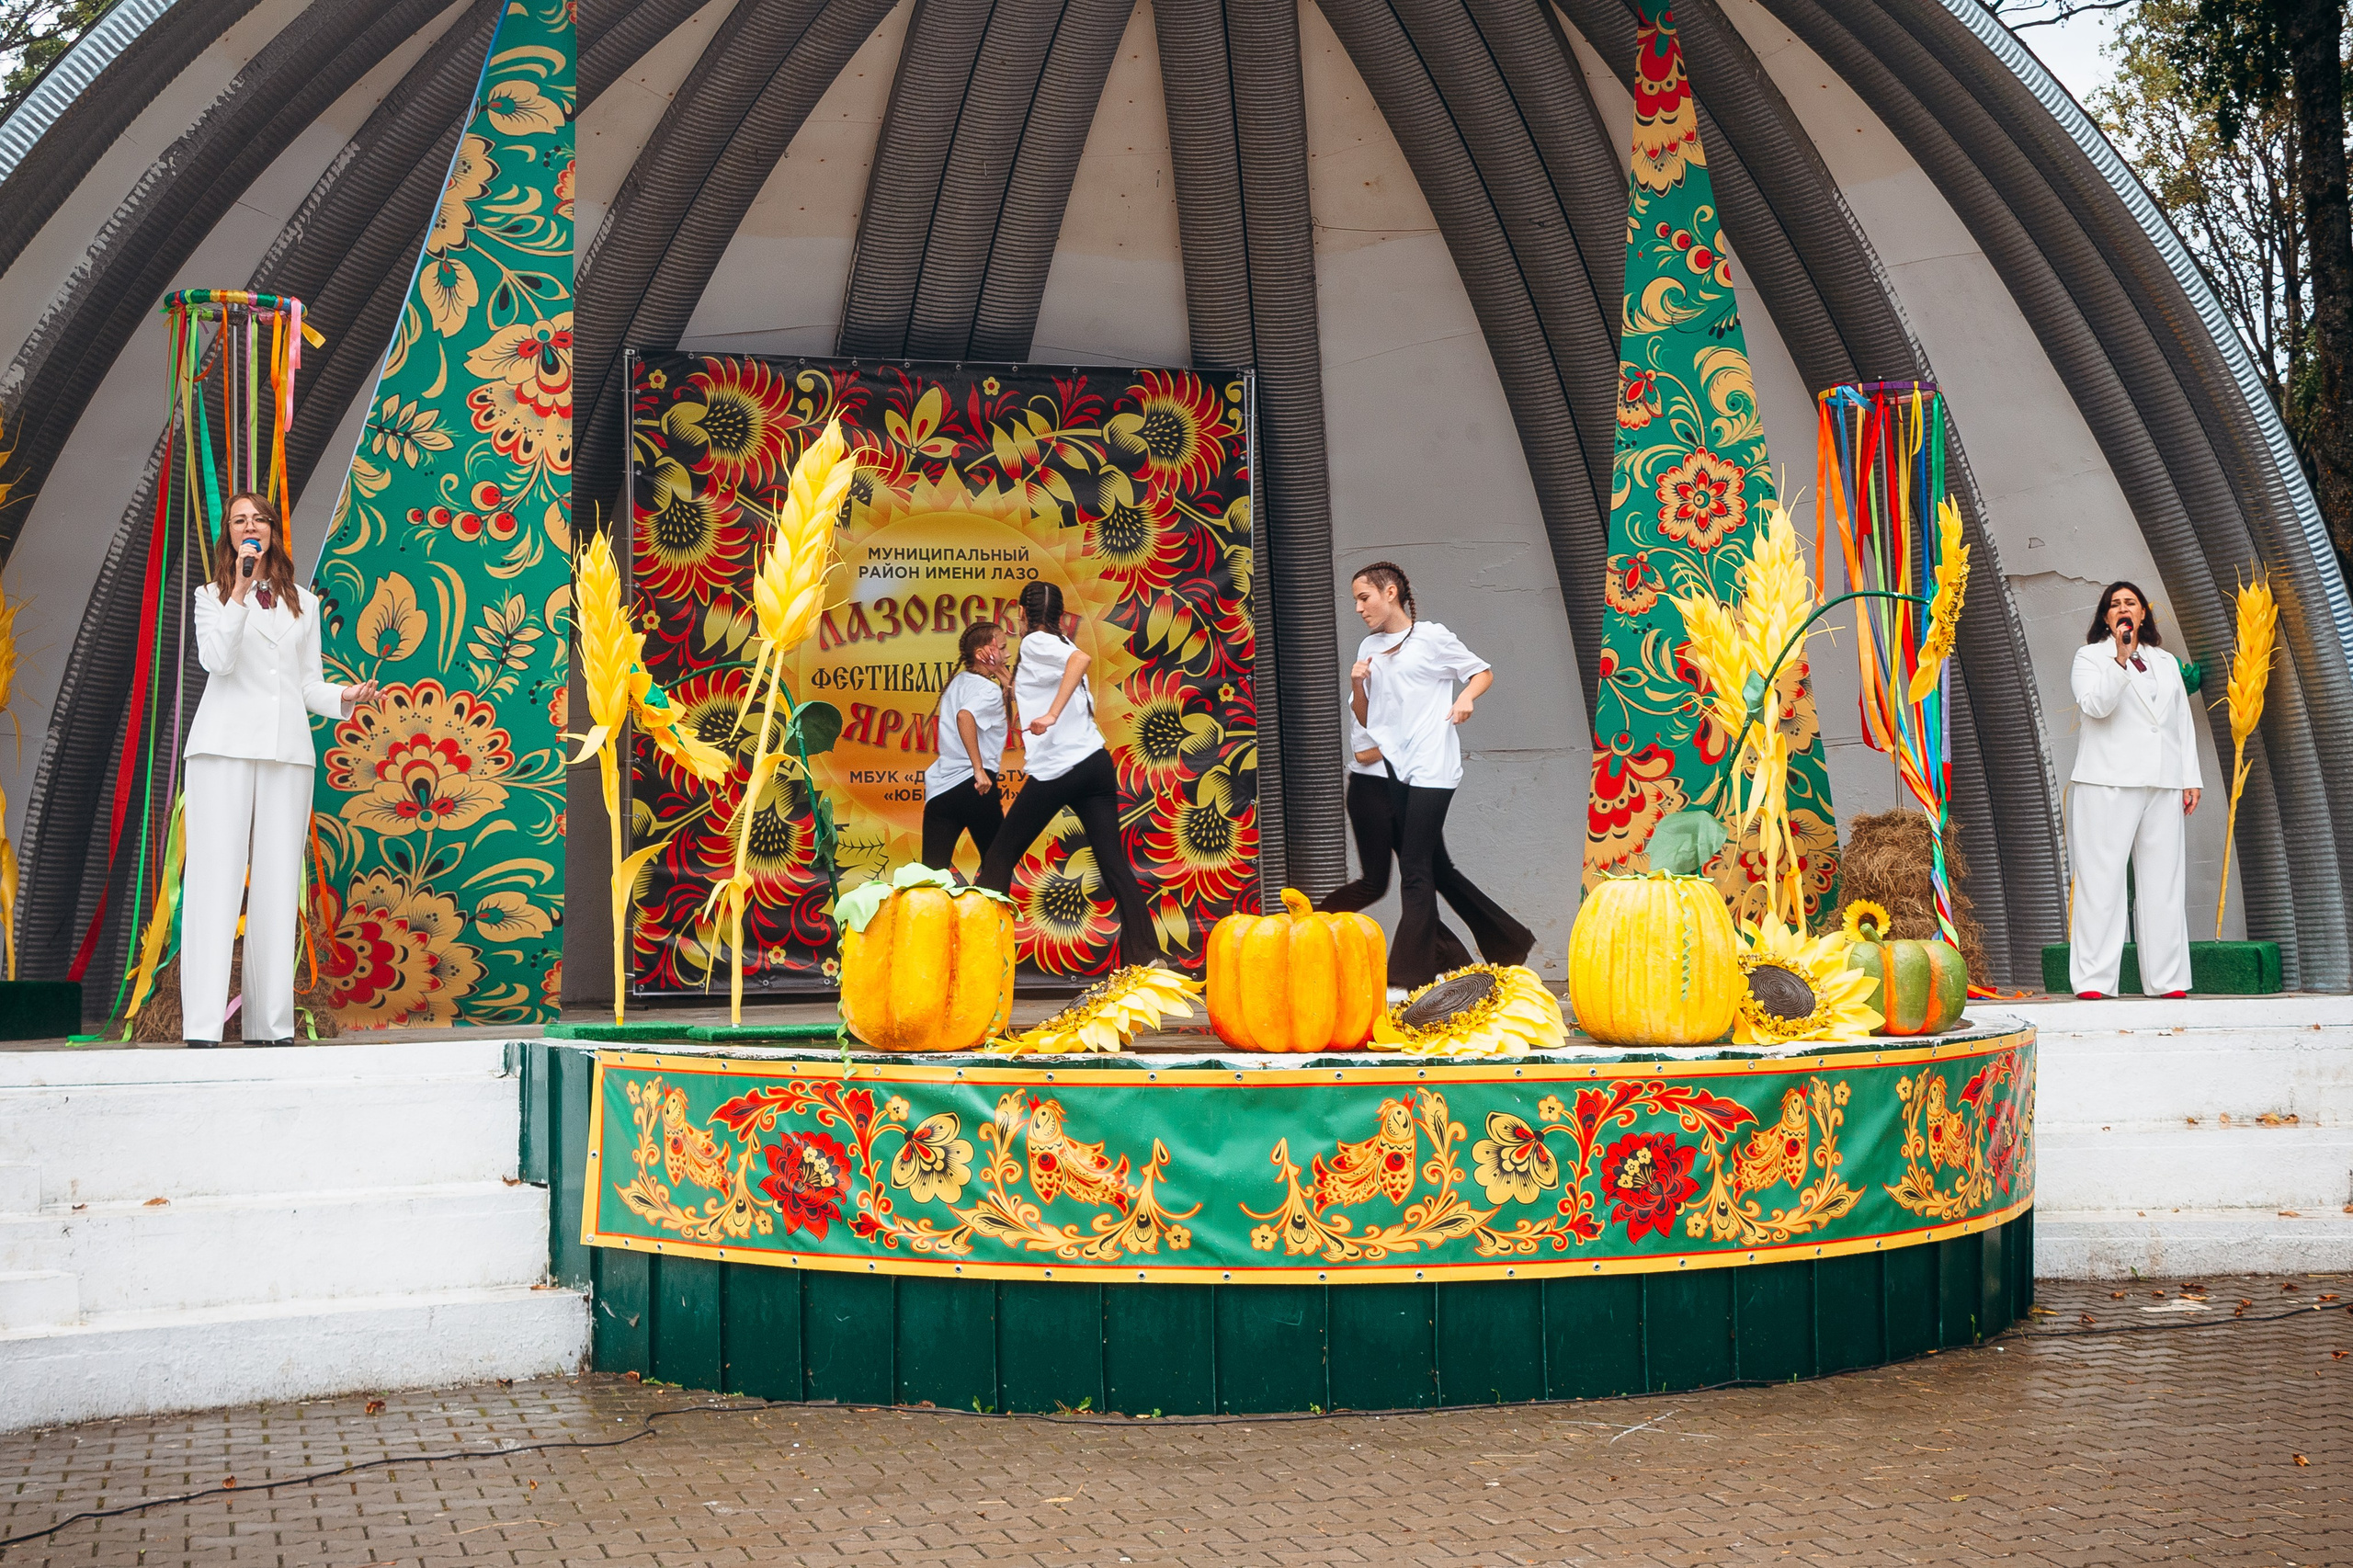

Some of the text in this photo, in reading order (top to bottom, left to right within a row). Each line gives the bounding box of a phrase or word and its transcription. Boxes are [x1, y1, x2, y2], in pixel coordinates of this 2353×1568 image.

[868, 546, 1029, 562] МУНИЦИПАЛЬНЫЙ
[858, 562, 1039, 580] РАЙОН ИМЕНИ ЛАЗО
[819, 593, 1082, 651] ЛАЗОВСКЯ
[849, 770, 899, 783] МБУК
